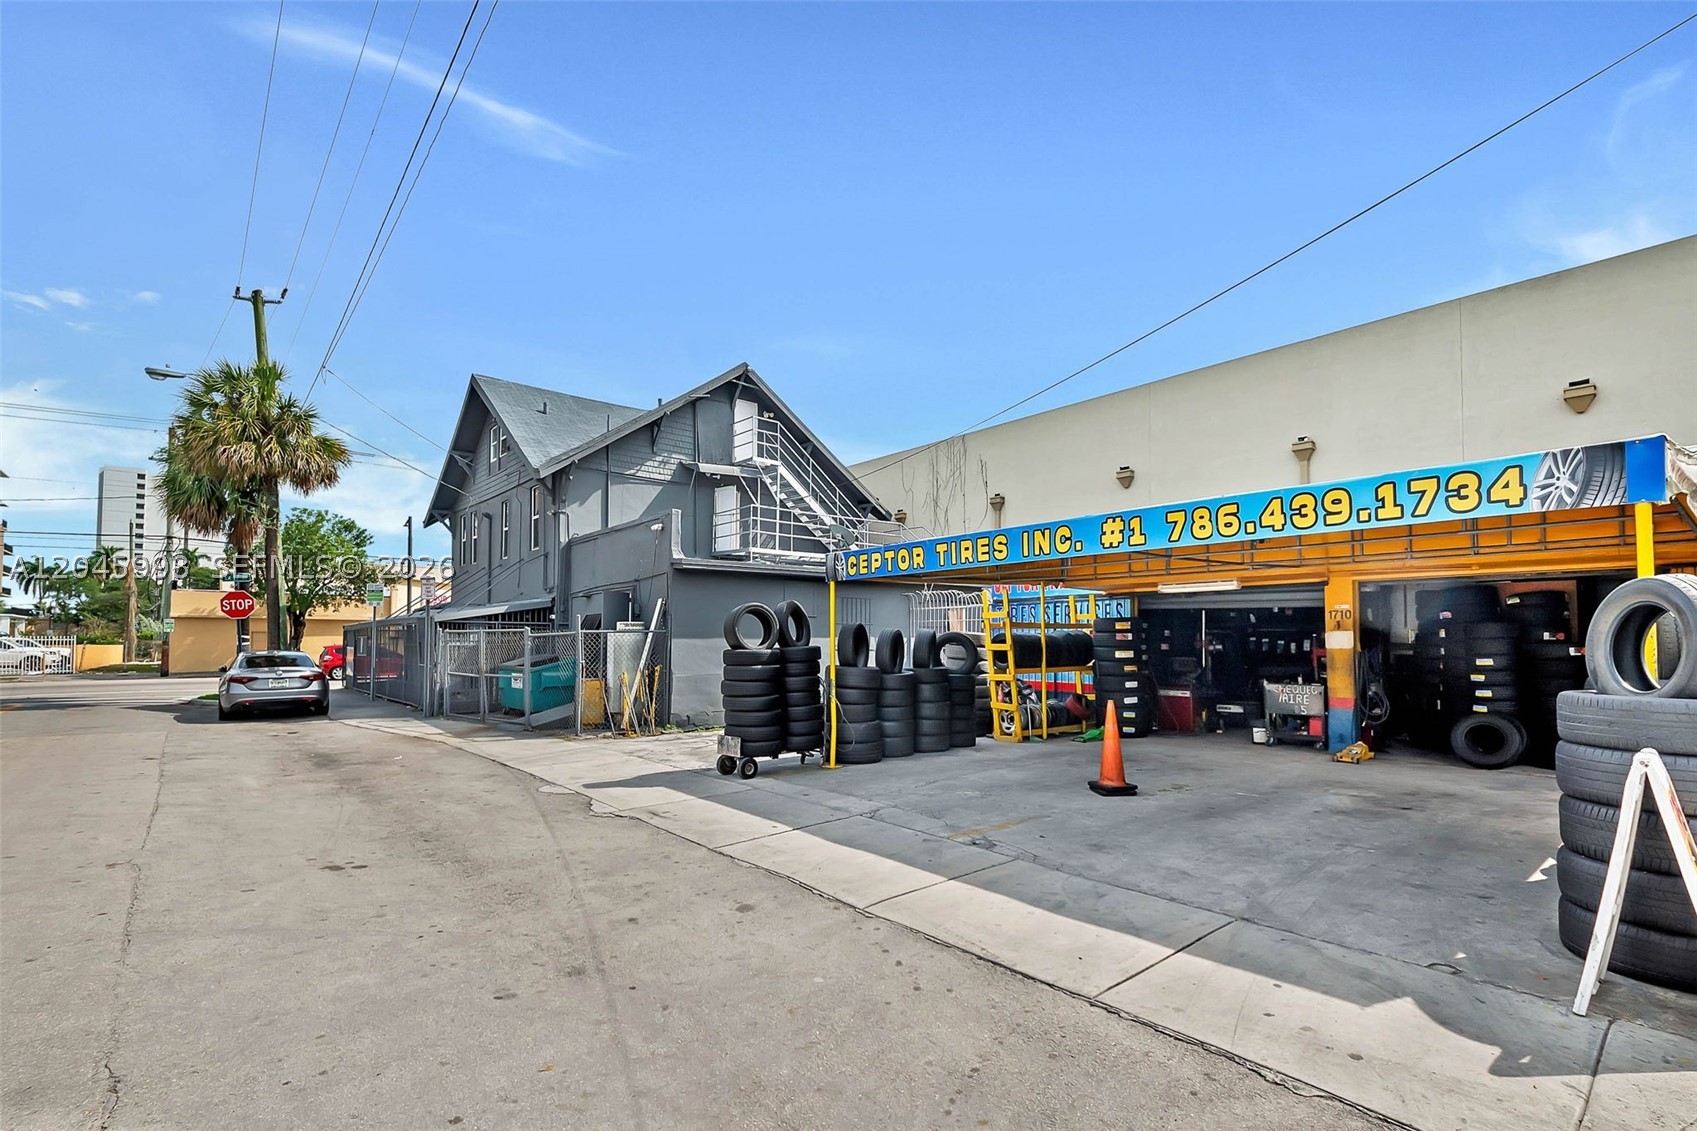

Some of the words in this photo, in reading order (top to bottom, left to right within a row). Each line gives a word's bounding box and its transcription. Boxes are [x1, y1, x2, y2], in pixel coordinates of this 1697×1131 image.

[847, 546, 925, 576] CEPTOR
[935, 534, 1008, 567] TIRES
[1021, 524, 1083, 557] INC.
[1100, 516, 1146, 549] #1
[1166, 465, 1528, 543] 786.439.1734
[222, 599, 253, 611] STOP
[996, 604, 1036, 623] TRES
[1328, 609, 1352, 620] 1710
